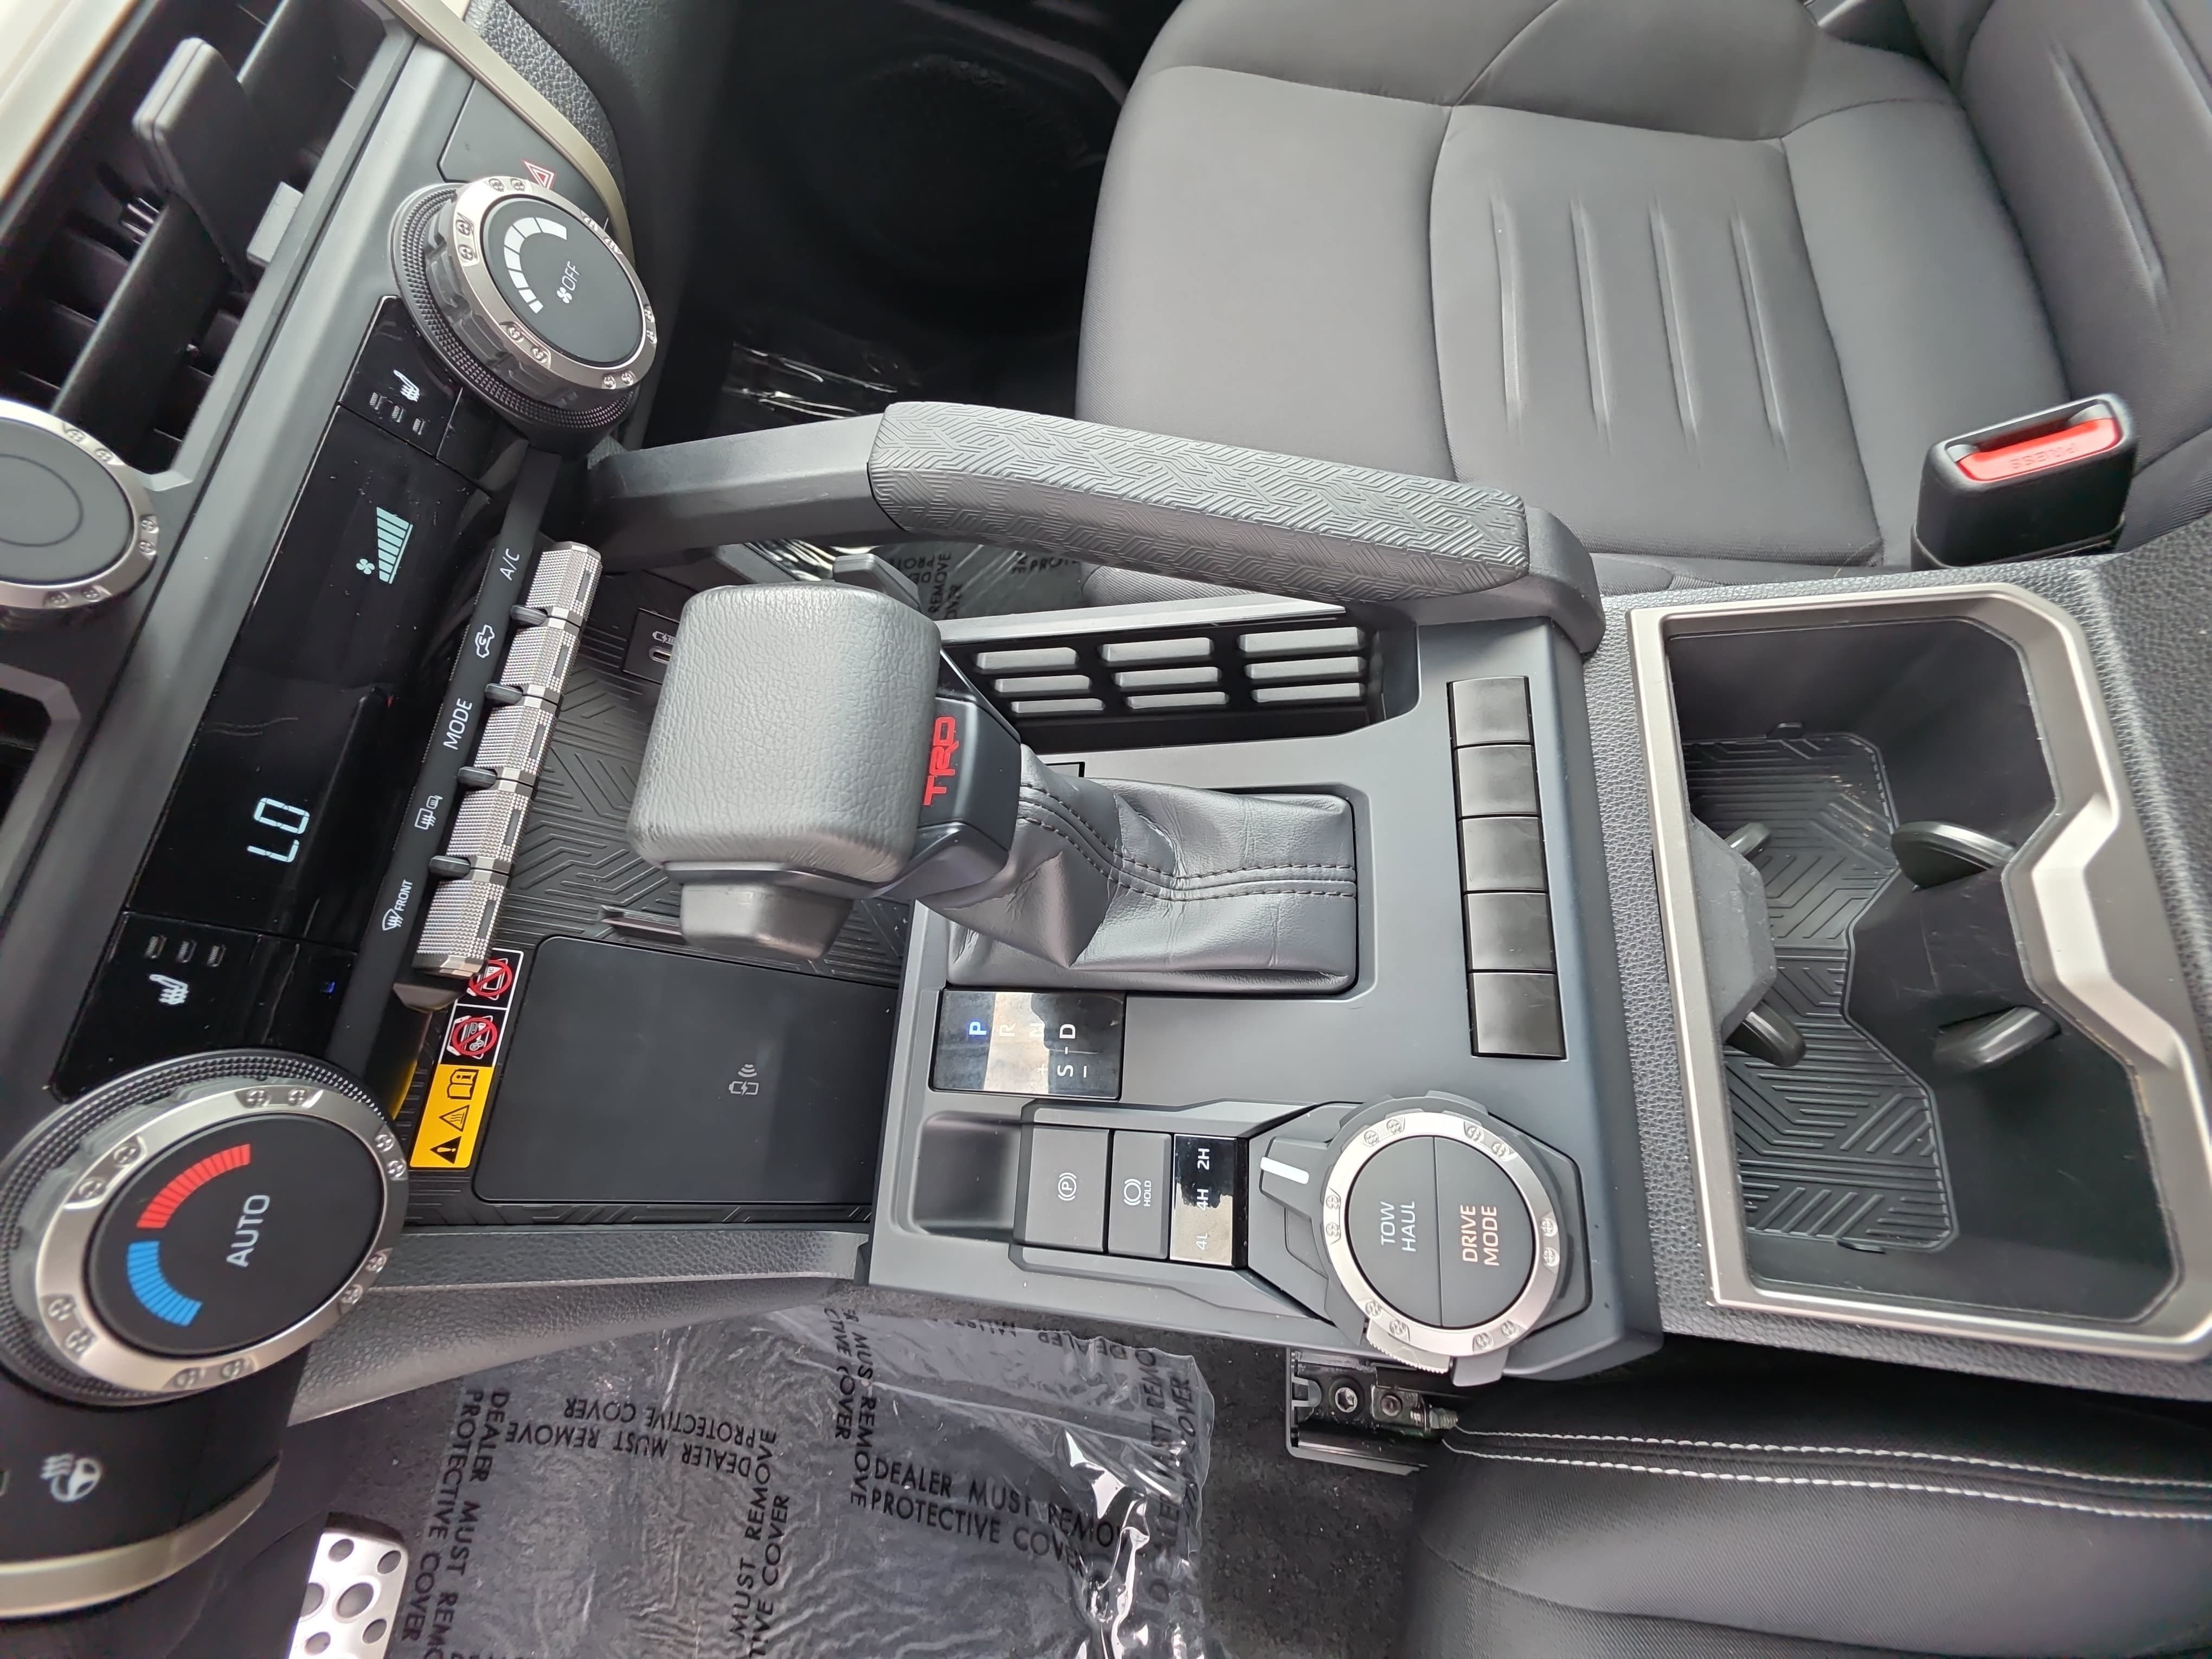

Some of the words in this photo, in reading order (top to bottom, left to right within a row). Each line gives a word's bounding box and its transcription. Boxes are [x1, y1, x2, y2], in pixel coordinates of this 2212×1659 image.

[563, 260, 581, 292] OFF
[2009, 442, 2078, 469] PRESS
[499, 548, 520, 581] A/C
[928, 552, 951, 613] REMOVE
[443, 698, 473, 750] MODE
[923, 716, 959, 806] TRD
[395, 879, 413, 912] FRONT
[969, 1021, 987, 1036] P
[999, 1023, 1015, 1037] R
[1030, 1023, 1045, 1038] N
[1059, 1024, 1076, 1039] D
[1057, 1064, 1073, 1077] S
[1197, 1148, 1210, 1170] 2H
[1197, 1188, 1209, 1211] 4H
[226, 1194, 270, 1268] AUTO
[1196, 1232, 1208, 1250] 4L
[1379, 1201, 1395, 1246] TOW
[1401, 1201, 1416, 1252] HAUL
[1460, 1204, 1479, 1263] DRIVE
[1481, 1205, 1500, 1266] MODE
[852, 1331, 873, 1387] MUS
[564, 1397, 636, 1423] COVER
[644, 1405, 756, 1448] PROTECTIVE
[468, 1388, 510, 1482] DEALER
[505, 1422, 600, 1449] REMOVE
[613, 1431, 668, 1457] MUST
[851, 1396, 877, 1507] REMOVE
[429, 1389, 484, 1538] PROTECTIVE
[681, 1442, 751, 1478] DEALER
[874, 1458, 953, 1498] DEALER
[968, 1480, 1032, 1517] MUST
[1047, 1501, 1129, 1551] REMOV
[449, 1500, 481, 1576] MUST
[730, 1557, 755, 1639] MUST
[745, 1430, 777, 1540] REMOVE
[762, 1496, 790, 1586] COVER
[871, 1489, 1001, 1544] PROTECTIVE
[1012, 1525, 1086, 1576] COVER
[401, 1553, 440, 1641] COVER
